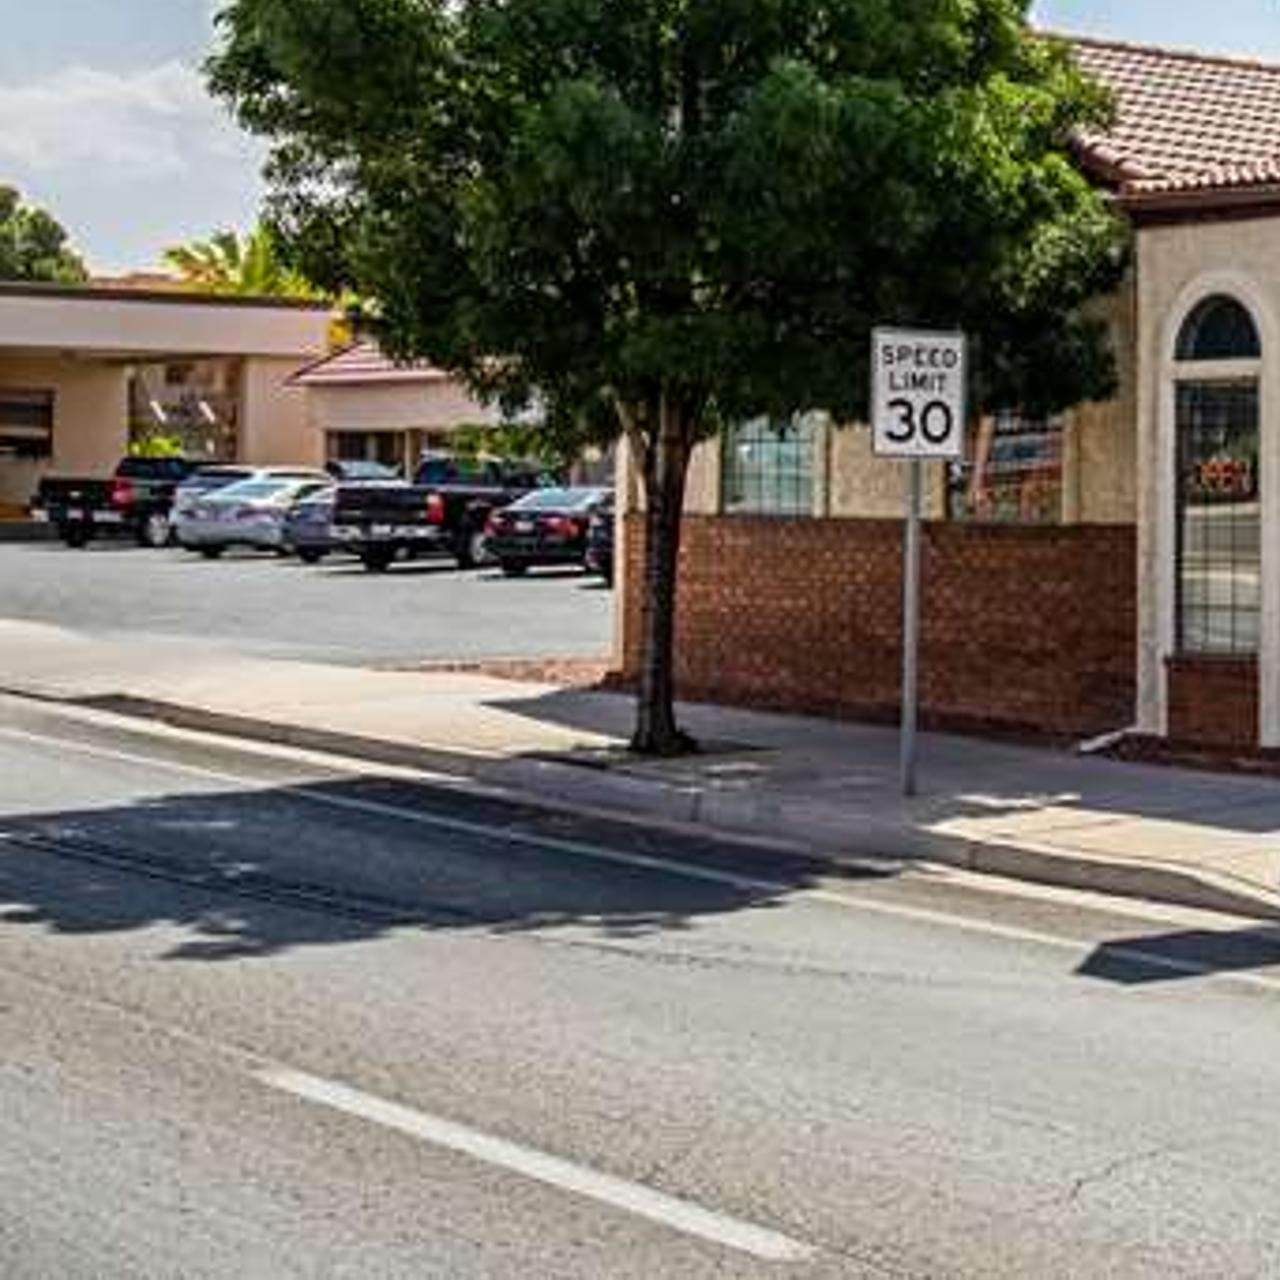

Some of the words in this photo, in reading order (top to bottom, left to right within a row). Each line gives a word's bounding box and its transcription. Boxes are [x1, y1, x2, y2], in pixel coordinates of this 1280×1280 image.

[881, 344, 959, 369] SPEED
[888, 370, 948, 394] LIMIT
[884, 398, 954, 444] 30
